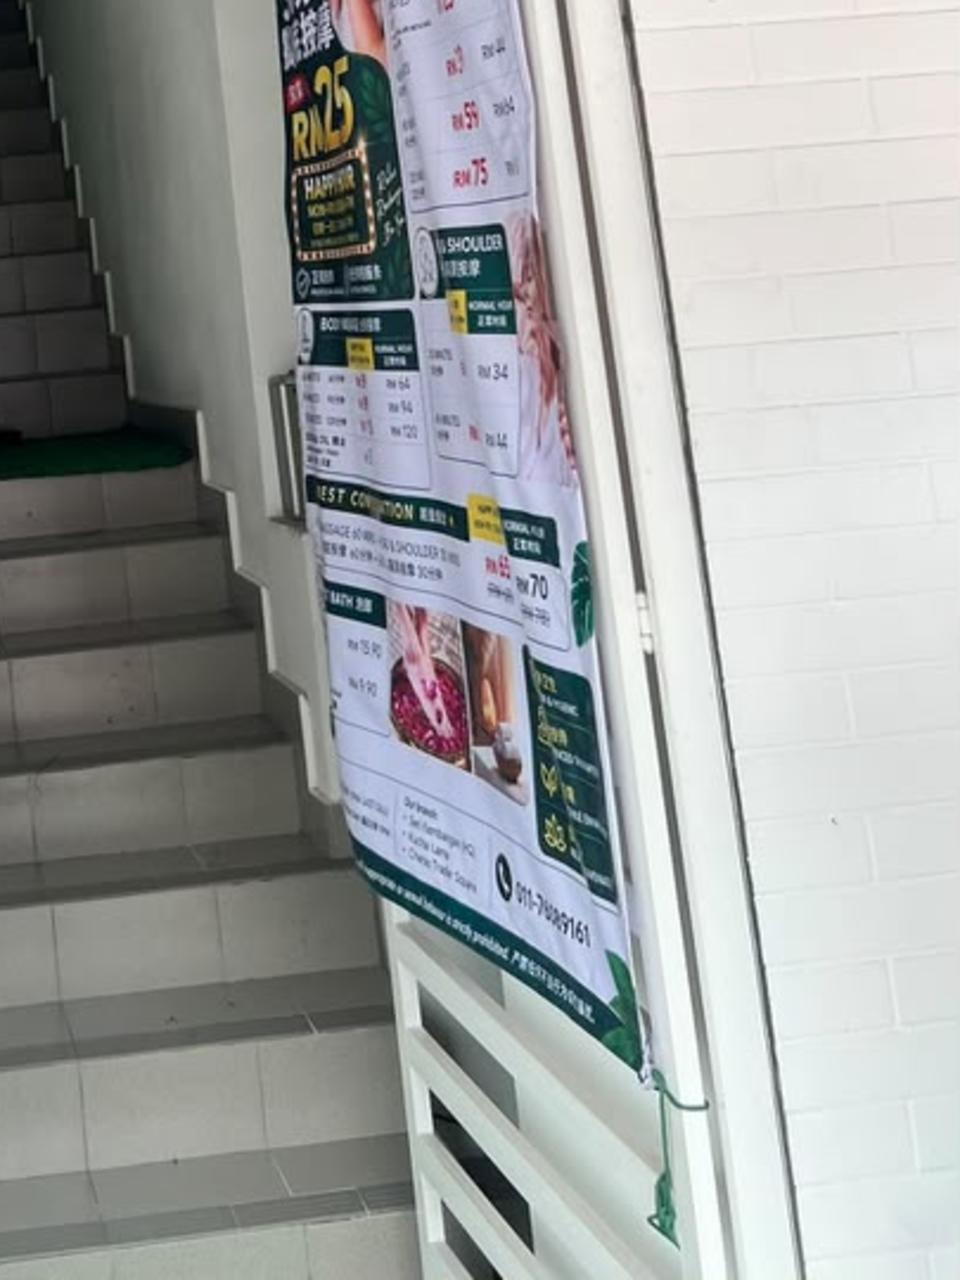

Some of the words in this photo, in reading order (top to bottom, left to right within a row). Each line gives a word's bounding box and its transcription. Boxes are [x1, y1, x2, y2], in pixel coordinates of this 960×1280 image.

[453, 168, 471, 188] RM
[471, 157, 489, 187] 75
[447, 234, 504, 253] SHOULDER
[530, 572, 549, 600] 70
